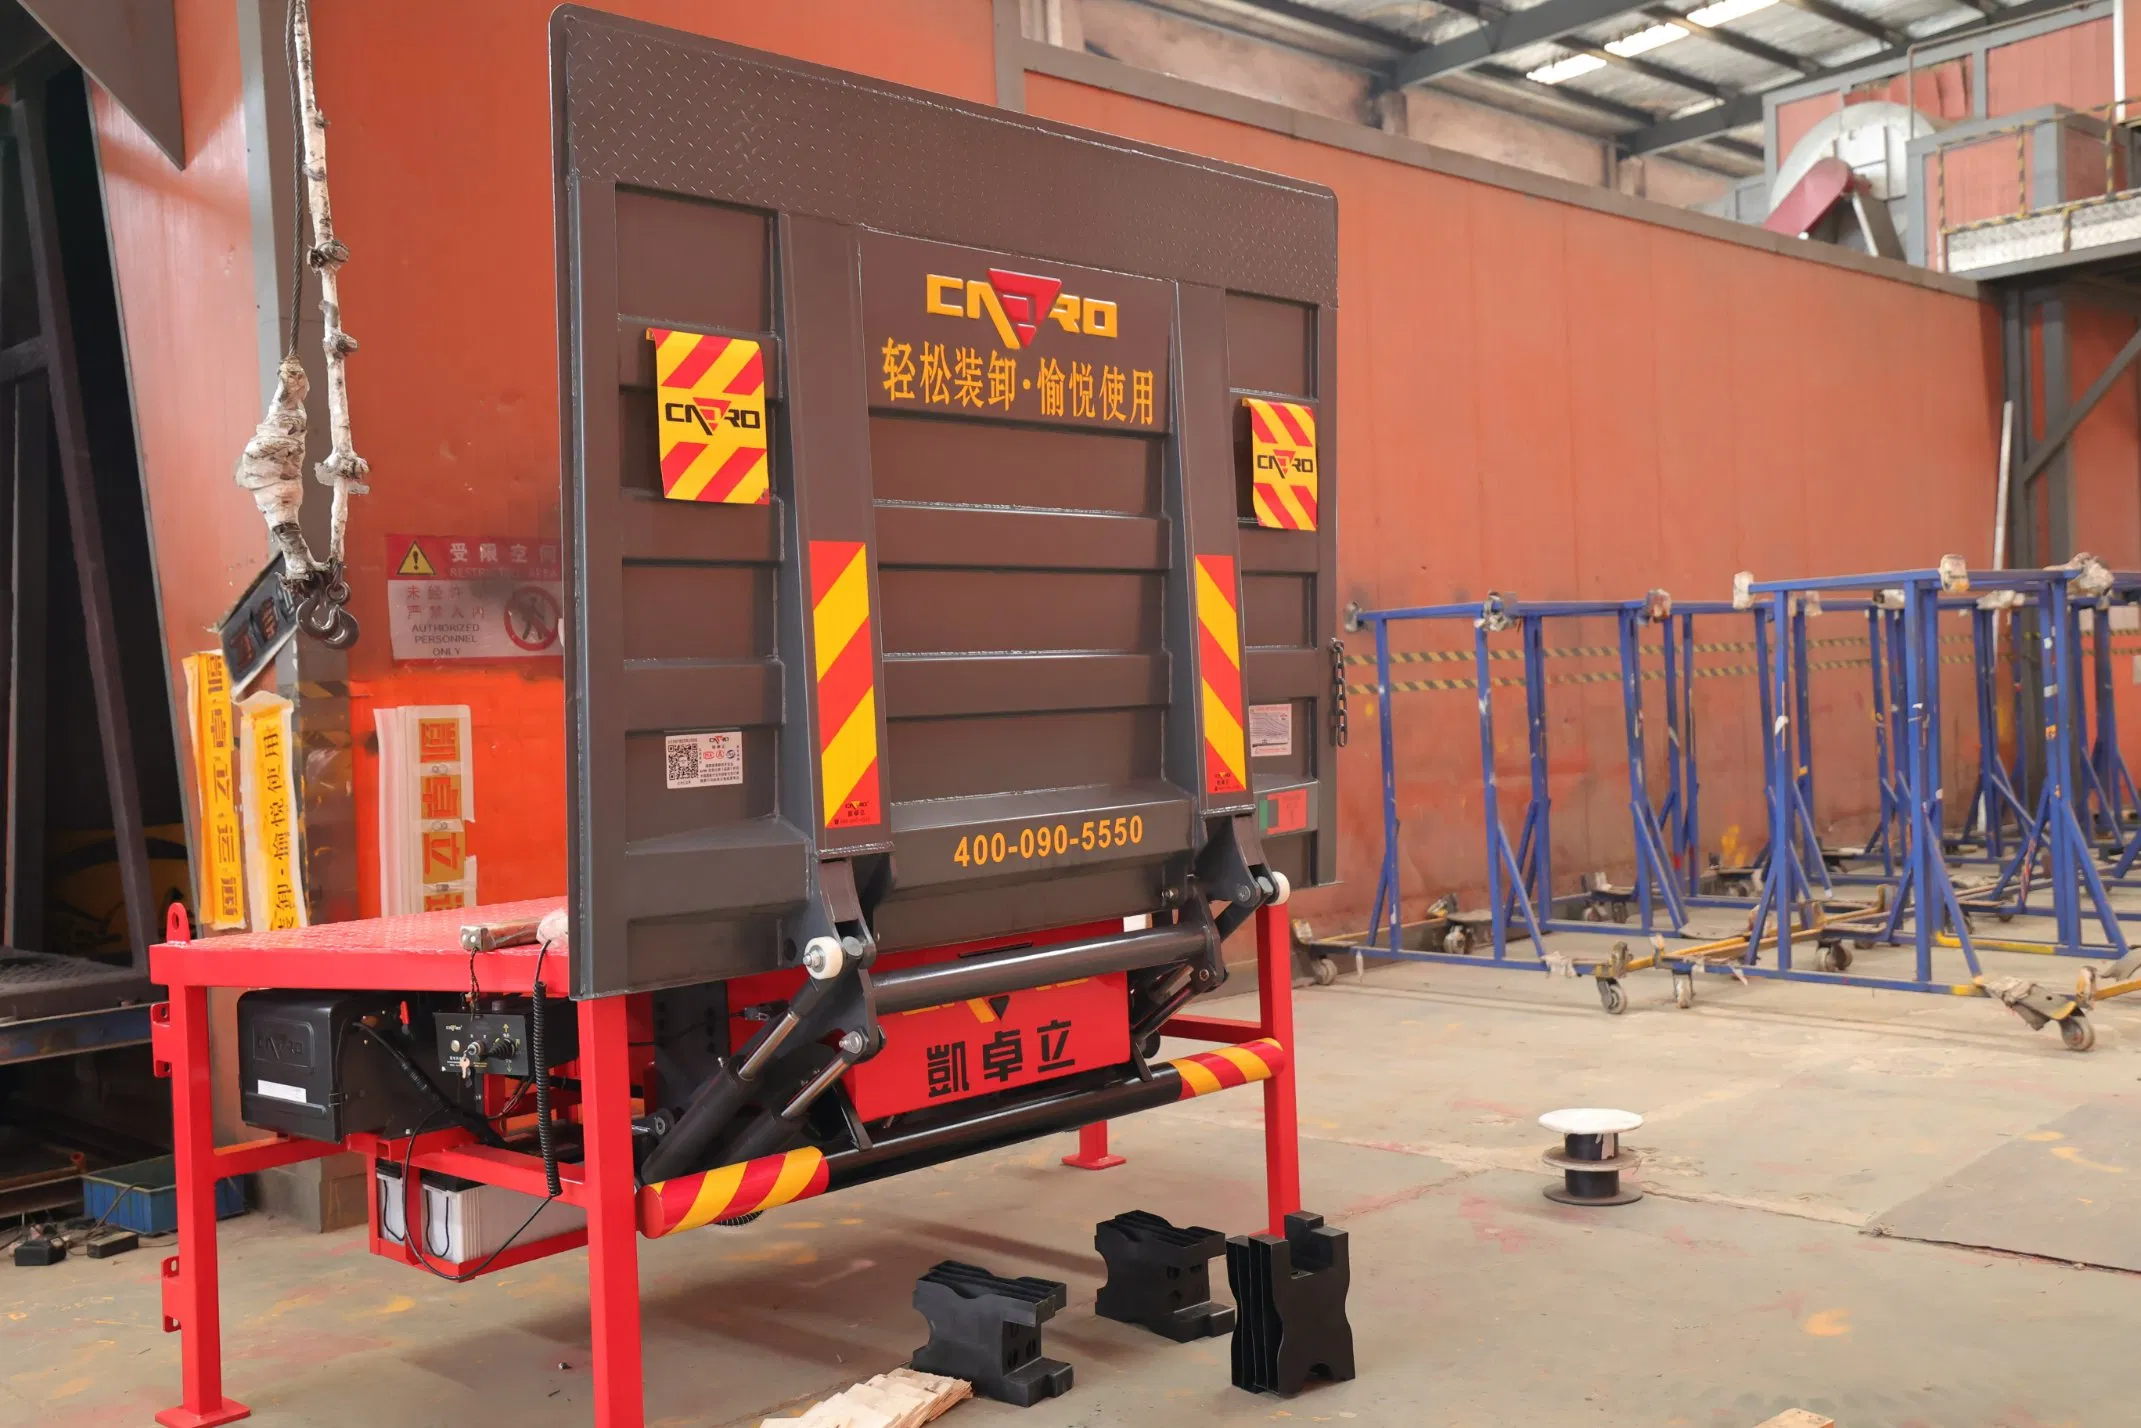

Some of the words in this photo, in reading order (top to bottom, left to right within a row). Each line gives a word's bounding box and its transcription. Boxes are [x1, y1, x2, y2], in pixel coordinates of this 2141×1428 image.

[881, 337, 1154, 425] 轻松装卸·愉悦使用
[411, 623, 480, 633] AUTHORIZED
[414, 634, 477, 645] PERSONNEL
[432, 647, 461, 656] ONLY
[953, 815, 1144, 868] 400-090-5550
